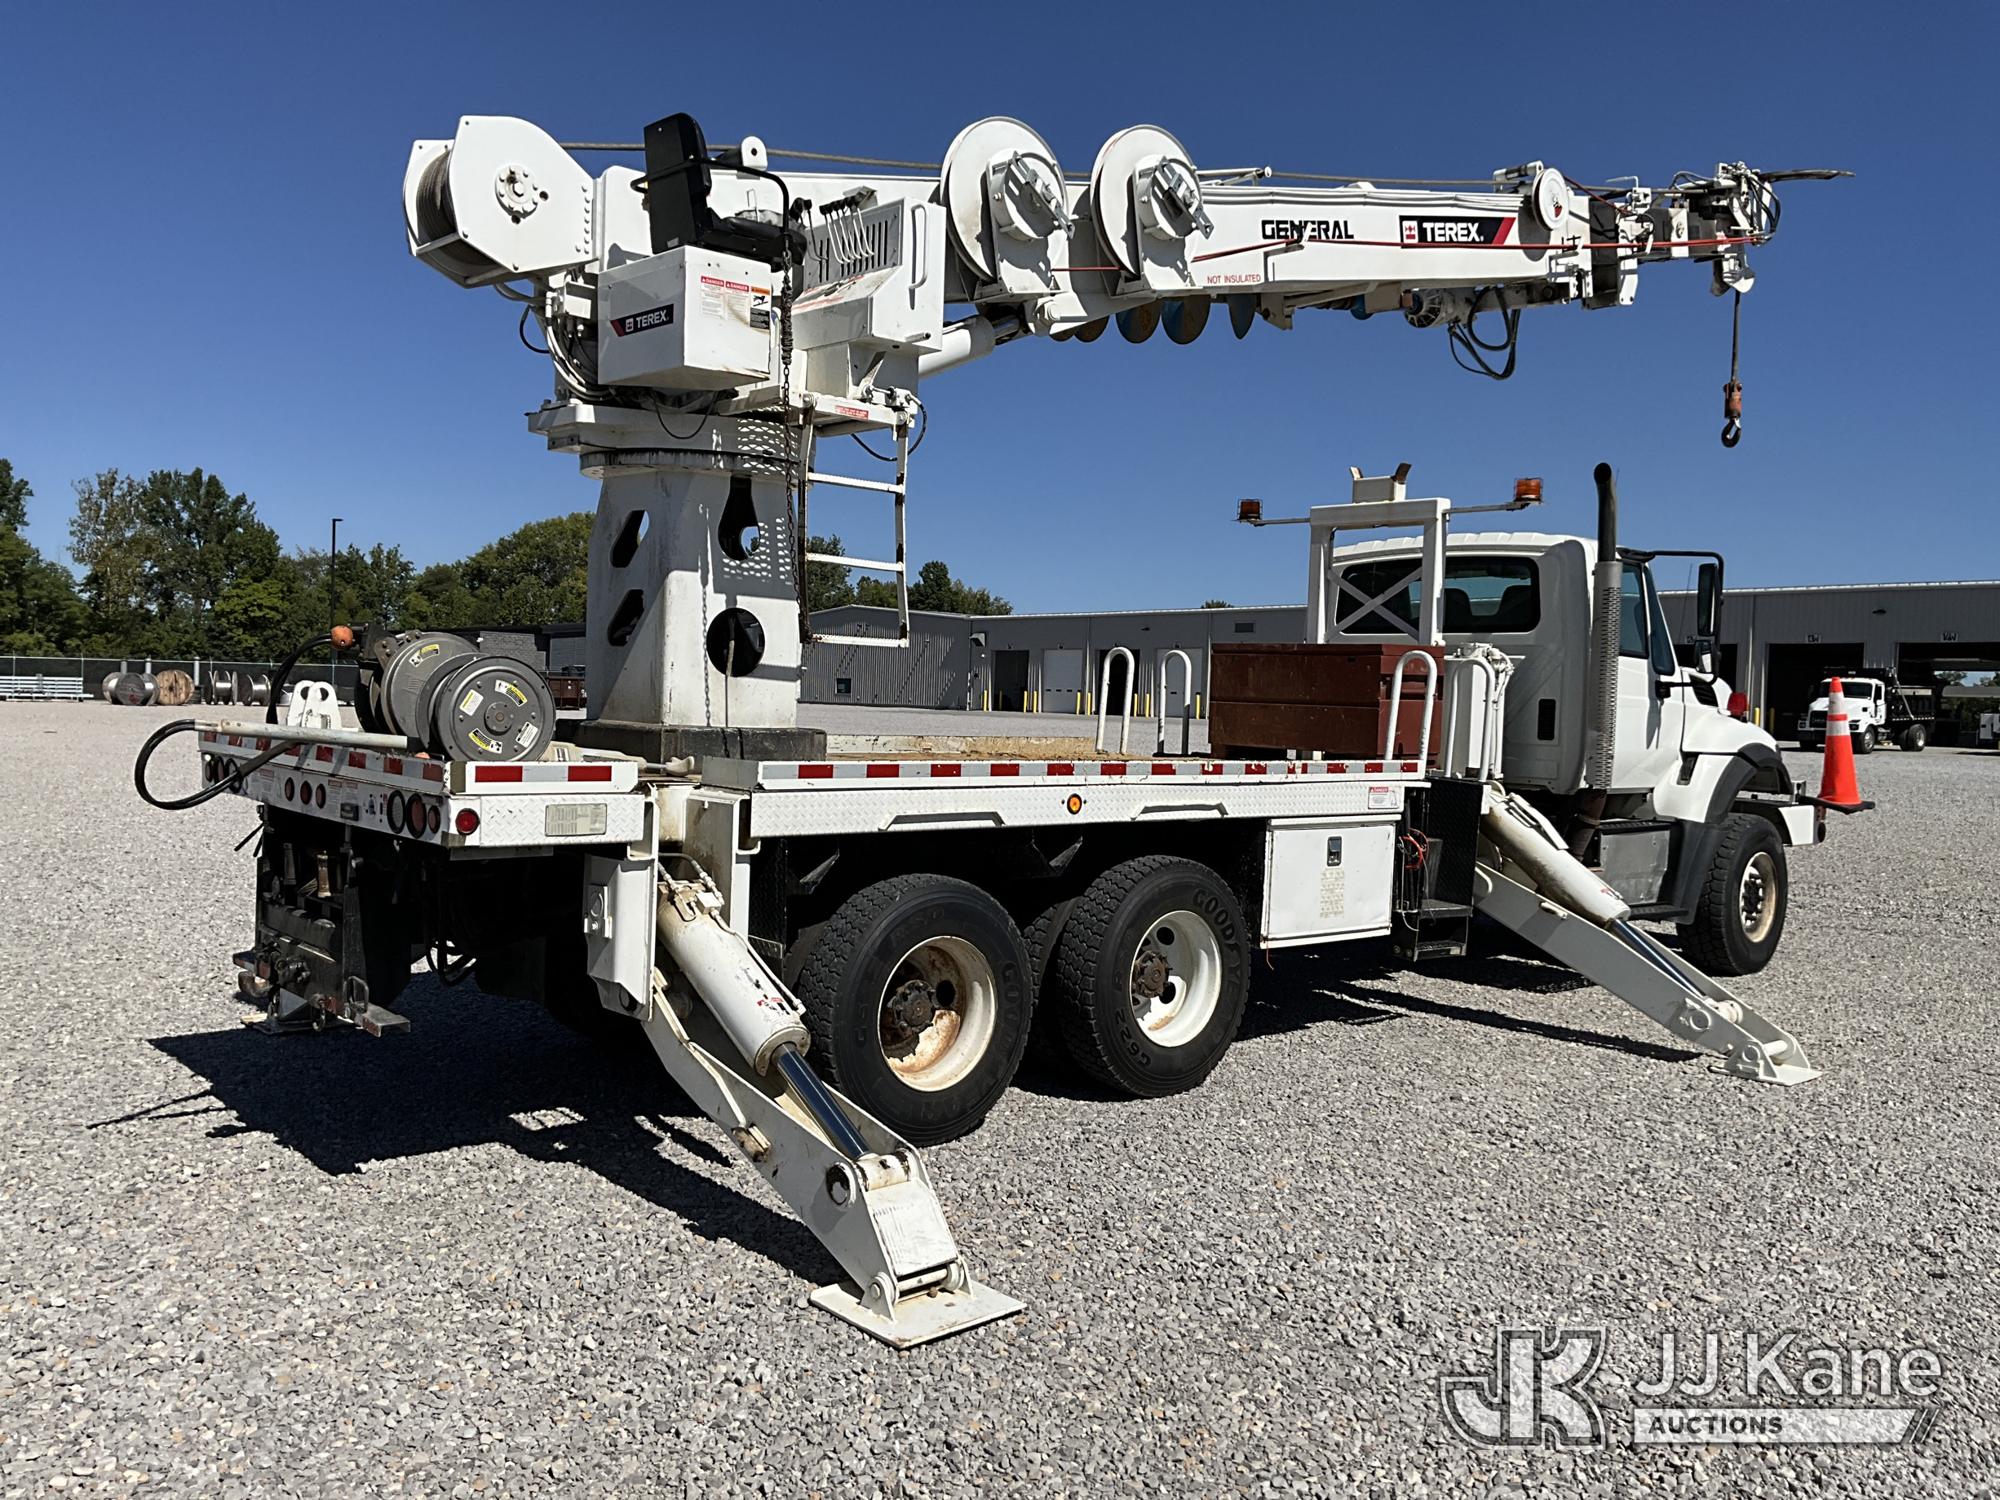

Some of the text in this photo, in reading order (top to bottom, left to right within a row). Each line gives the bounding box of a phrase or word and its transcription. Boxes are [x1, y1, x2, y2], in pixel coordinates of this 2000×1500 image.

[1261, 219, 1355, 240] GENERAL
[1422, 222, 1481, 242] TEREX
[1207, 274, 1261, 284] NOT INSULATED
[635, 309, 667, 329] TEREX
